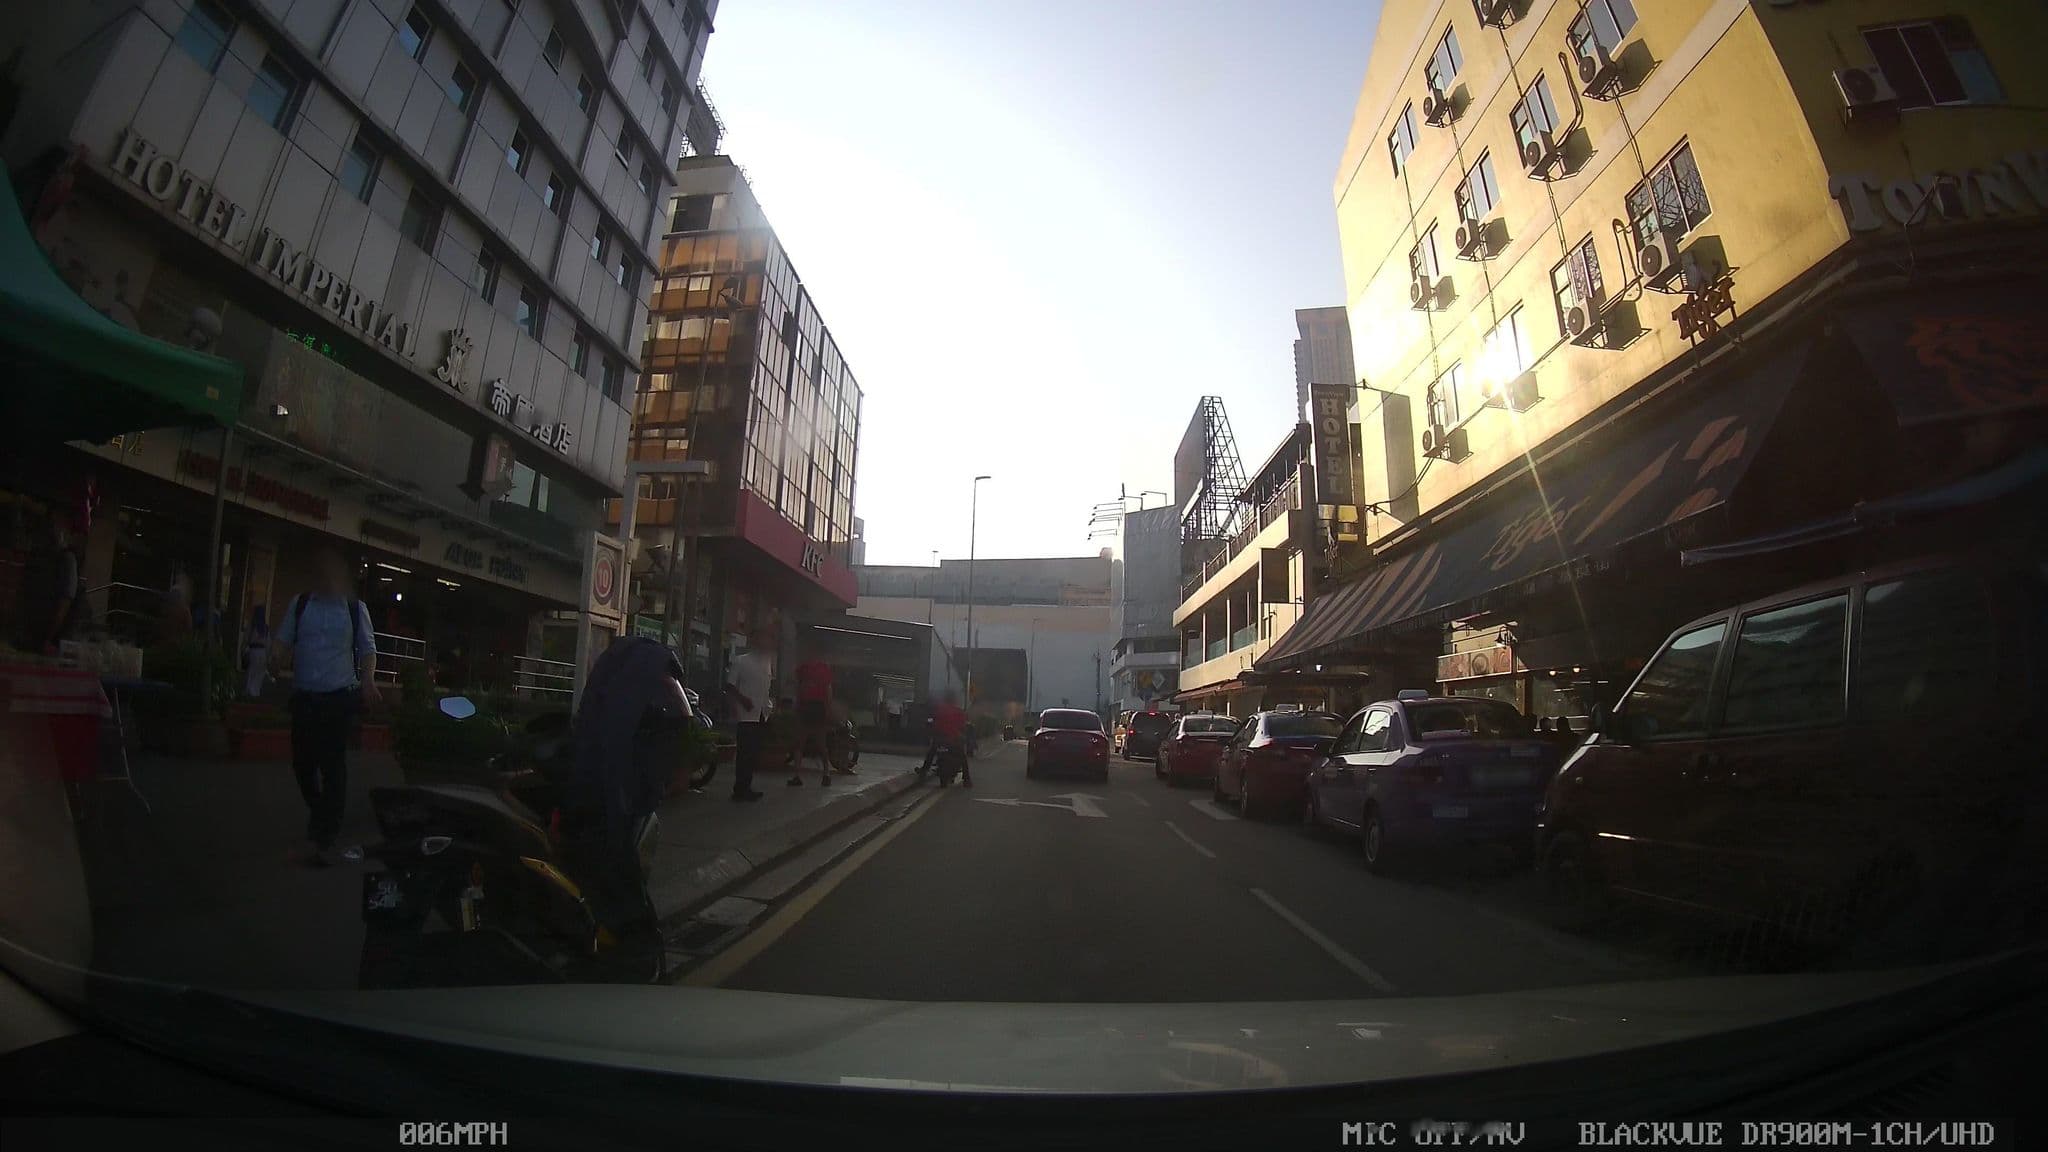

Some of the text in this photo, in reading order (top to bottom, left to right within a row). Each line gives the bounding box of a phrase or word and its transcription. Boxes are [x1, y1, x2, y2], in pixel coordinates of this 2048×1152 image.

[109, 127, 418, 360] HOTEL IMPERIAL
[1320, 398, 1344, 495] HOTEL
[801, 543, 824, 579] KFC
